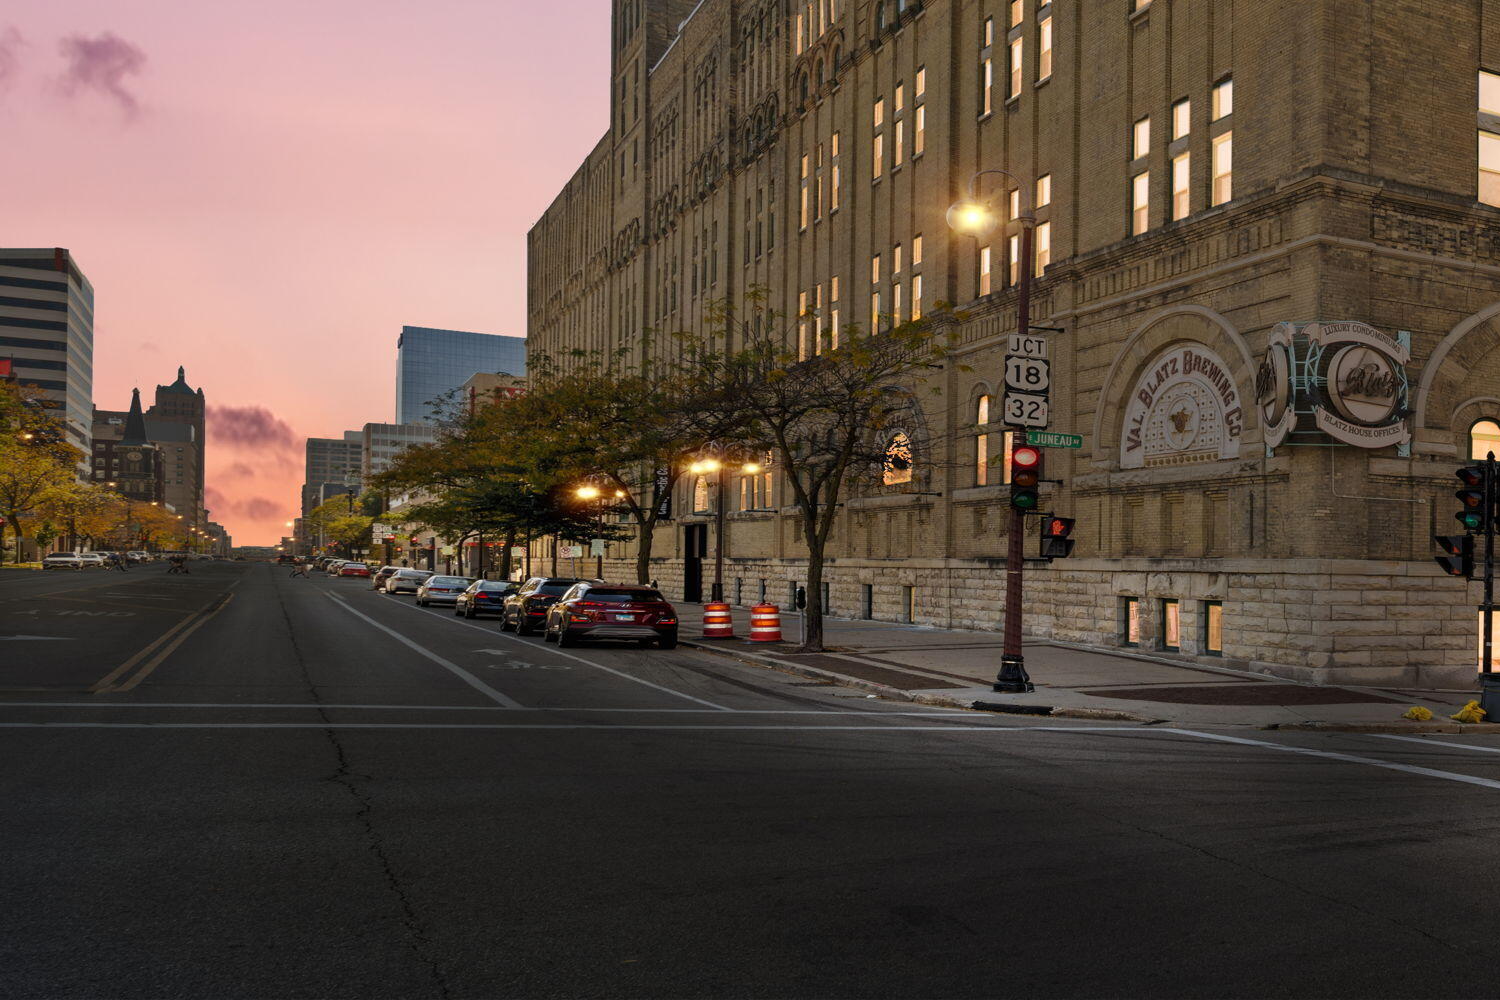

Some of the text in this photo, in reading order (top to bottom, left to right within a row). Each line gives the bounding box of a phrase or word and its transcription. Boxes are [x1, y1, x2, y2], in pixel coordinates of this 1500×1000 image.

[1011, 338, 1044, 353] JCT
[1324, 323, 1401, 354] LUXURY CONDOMINIUMS
[1015, 365, 1040, 384] 18
[1012, 399, 1040, 420] 32
[1126, 411, 1146, 452] VAL.
[1138, 358, 1178, 409] BLATZ
[1182, 350, 1235, 407] BREWING
[1324, 413, 1400, 438] BLATZ HOUSE OFFICES
[1034, 433, 1072, 446] JUNEAU
